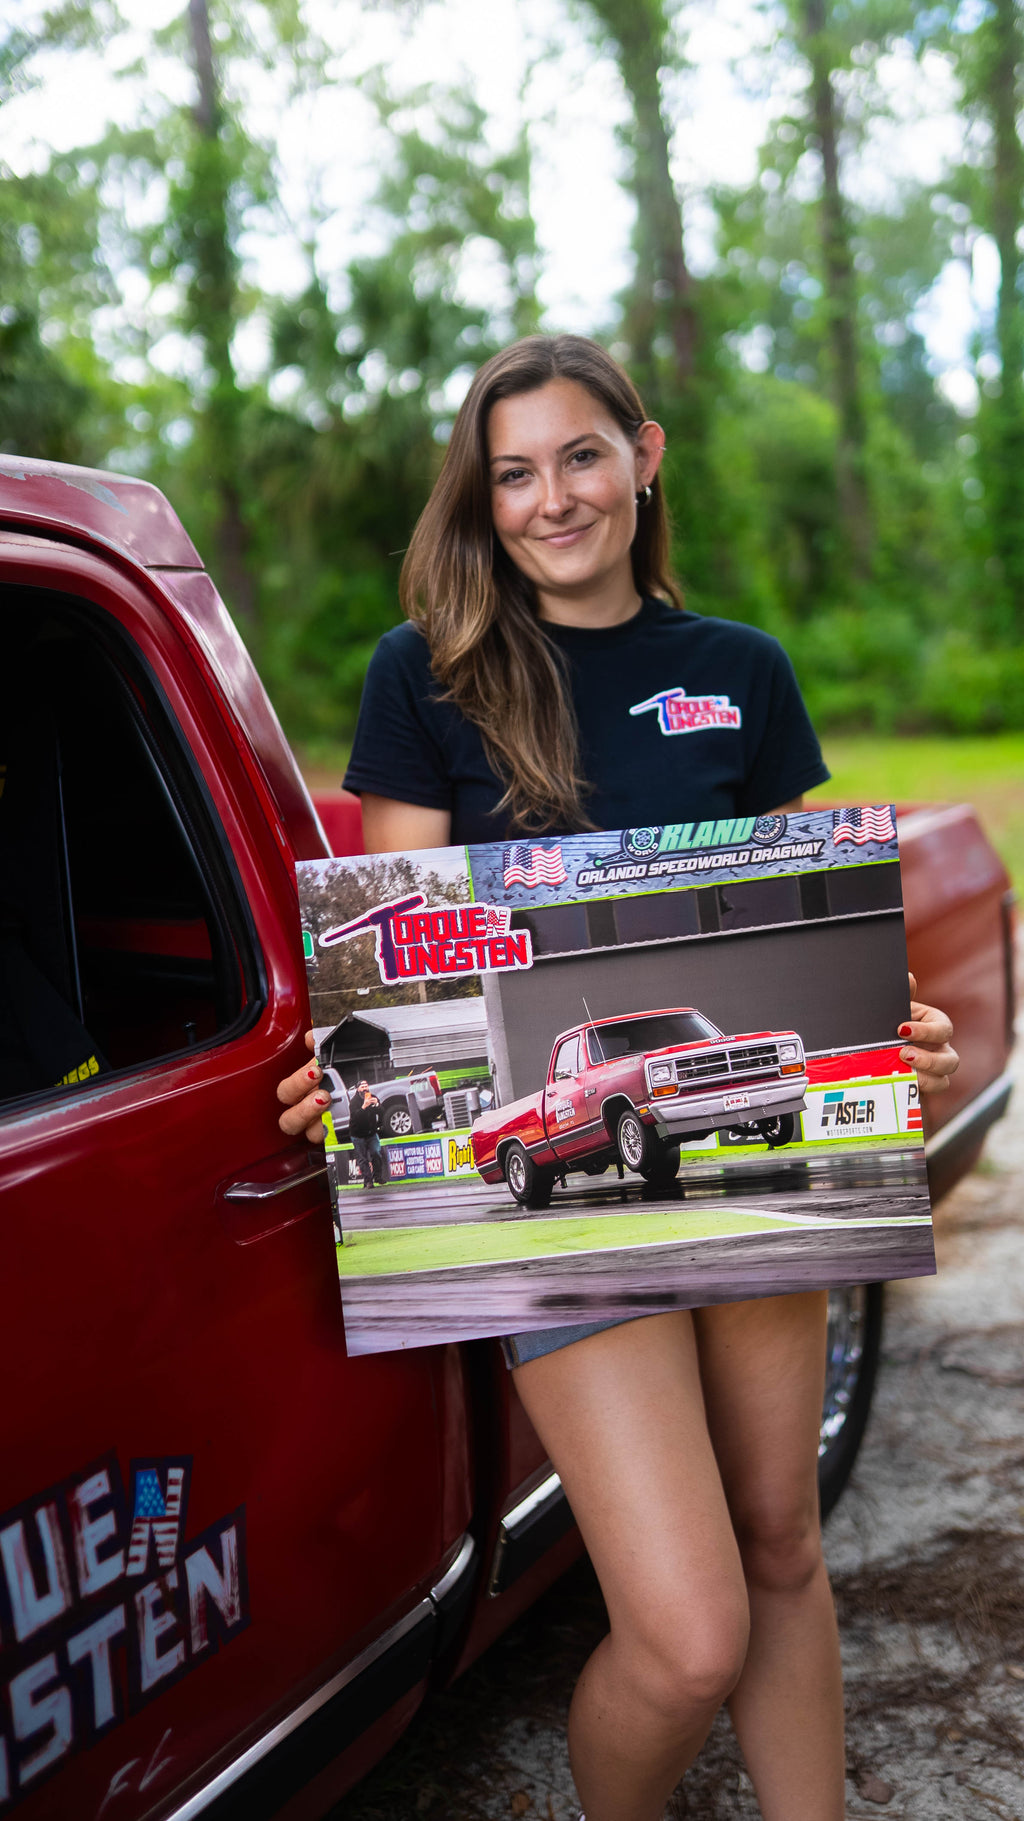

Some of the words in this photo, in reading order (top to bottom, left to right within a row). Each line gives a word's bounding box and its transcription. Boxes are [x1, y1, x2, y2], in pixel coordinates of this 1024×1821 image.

[577, 864, 648, 885] ORLANDO
[648, 851, 750, 876] SPEEDWORLD
[750, 841, 823, 863] DRAGWAY
[627, 842, 659, 856] WORLD
[325, 895, 487, 948] TORQUE
[382, 934, 528, 980] TUNGSTEN
[821, 1092, 875, 1126] FASTER
[389, 1162, 405, 1175] MOLY
[426, 1158, 442, 1172] MOLY
[0, 1524, 240, 1799] STEN
